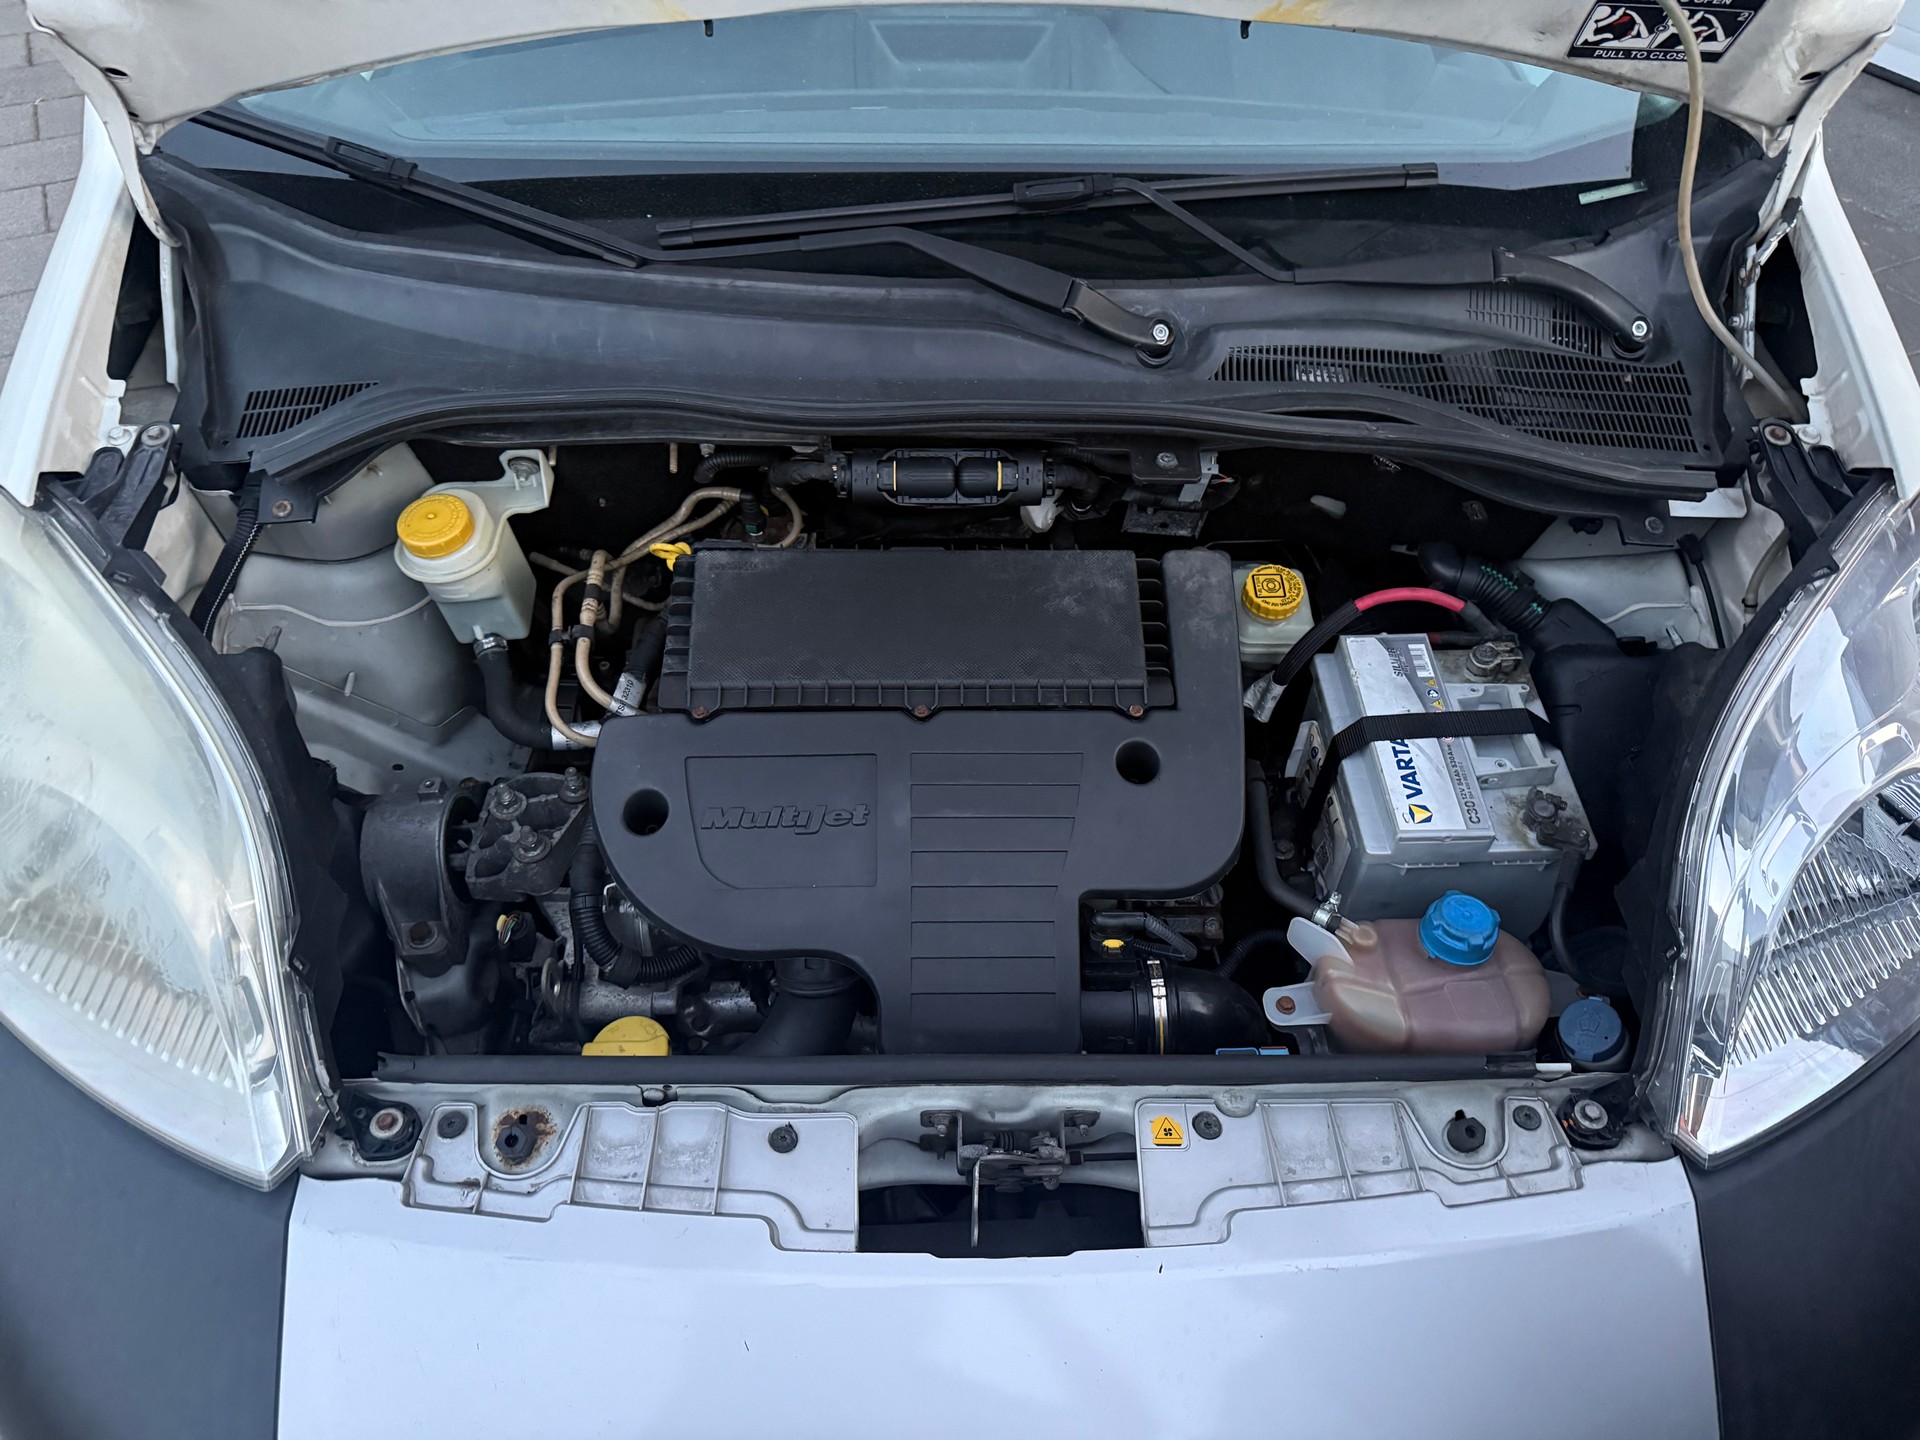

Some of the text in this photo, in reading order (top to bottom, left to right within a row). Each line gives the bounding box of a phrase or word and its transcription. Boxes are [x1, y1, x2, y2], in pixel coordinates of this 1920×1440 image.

[1737, 12, 1748, 21] 2
[1593, 50, 1687, 60] PULL TO CLOS
[1390, 739, 1423, 800] VARTA
[1458, 788, 1467, 800] 12V
[1464, 800, 1481, 824] C30
